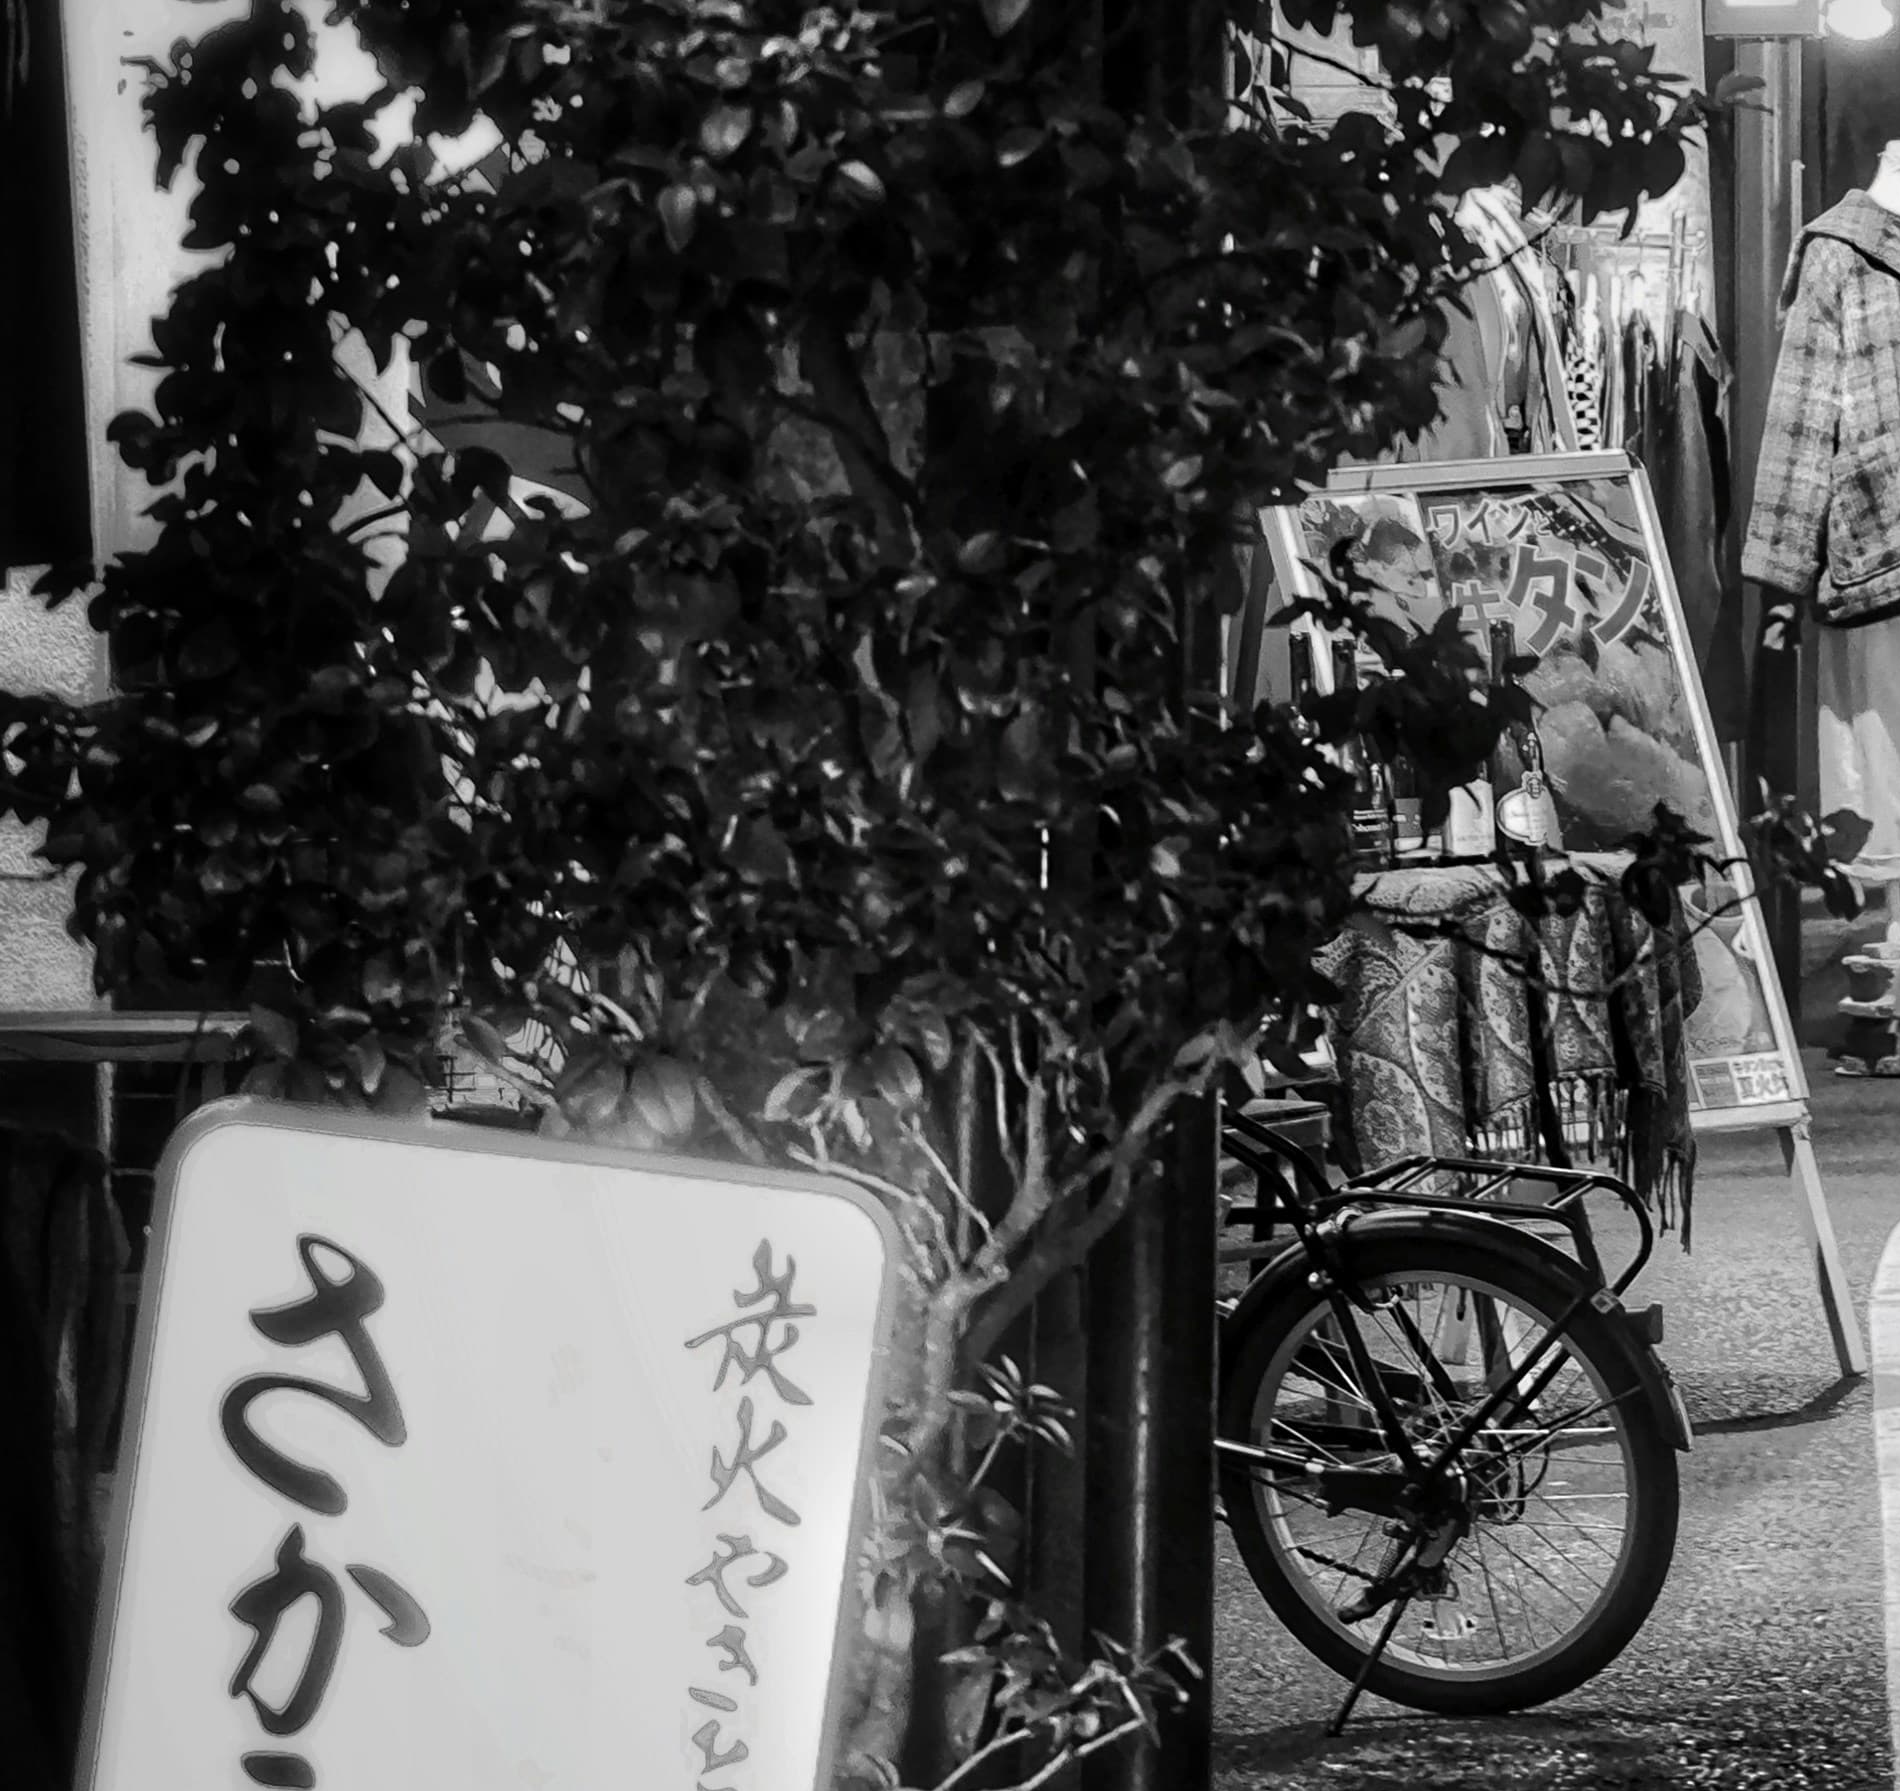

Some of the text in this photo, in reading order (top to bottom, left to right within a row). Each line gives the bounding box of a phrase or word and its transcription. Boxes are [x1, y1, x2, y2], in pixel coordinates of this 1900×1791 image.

[1428, 498, 1552, 549] ワインと
[1451, 543, 1651, 657] 牛タン
